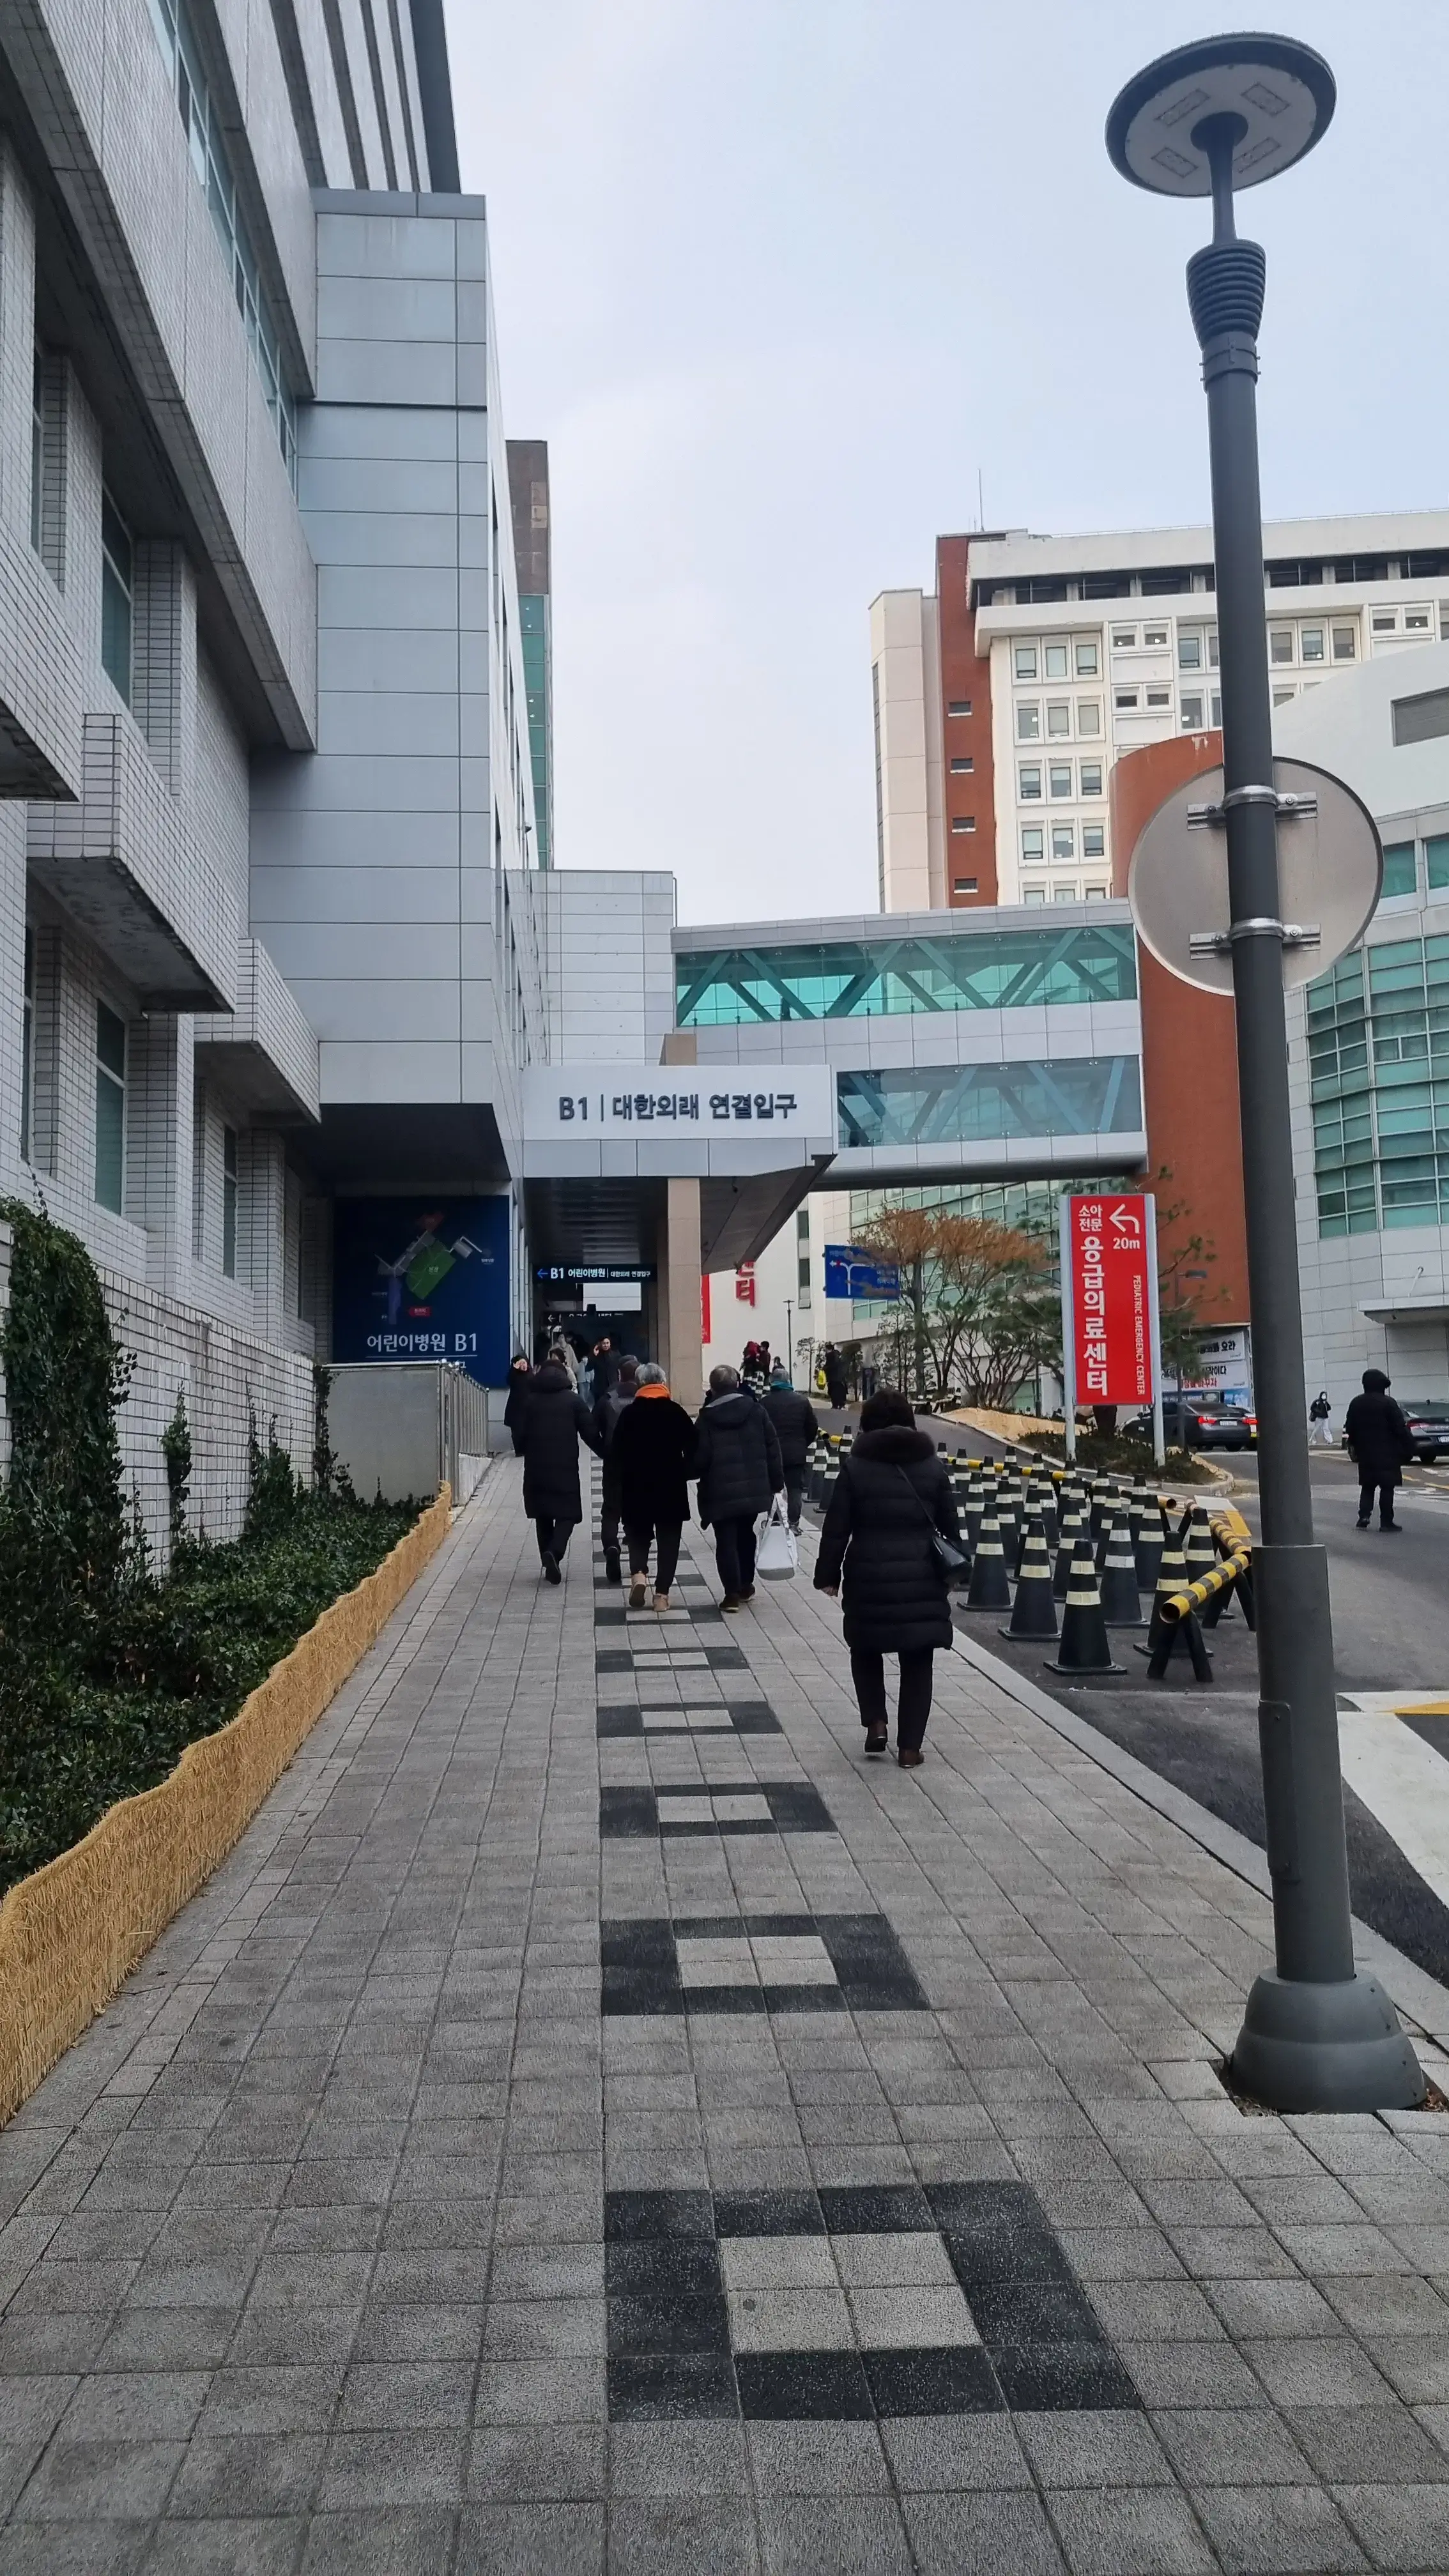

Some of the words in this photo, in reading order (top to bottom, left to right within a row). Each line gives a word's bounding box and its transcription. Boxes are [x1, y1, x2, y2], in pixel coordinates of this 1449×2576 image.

[559, 1096, 587, 1120] B1
[612, 1093, 699, 1120] 대한외래
[709, 1093, 797, 1119] 연결입구
[1078, 1204, 1103, 1218] 소아
[1079, 1218, 1103, 1232] 전문
[1112, 1237, 1140, 1250] 20m
[550, 1268, 564, 1279] B1
[568, 1268, 606, 1278] 어린이병원
[1133, 1275, 1142, 1314] PEDIATRIC
[1080, 1236, 1108, 1397] 응급의료센터
[367, 1333, 446, 1353] 어린이병원
[455, 1333, 477, 1352] B1
[1135, 1316, 1144, 1365] EMERGENCY
[1136, 1365, 1146, 1395] CENTER
